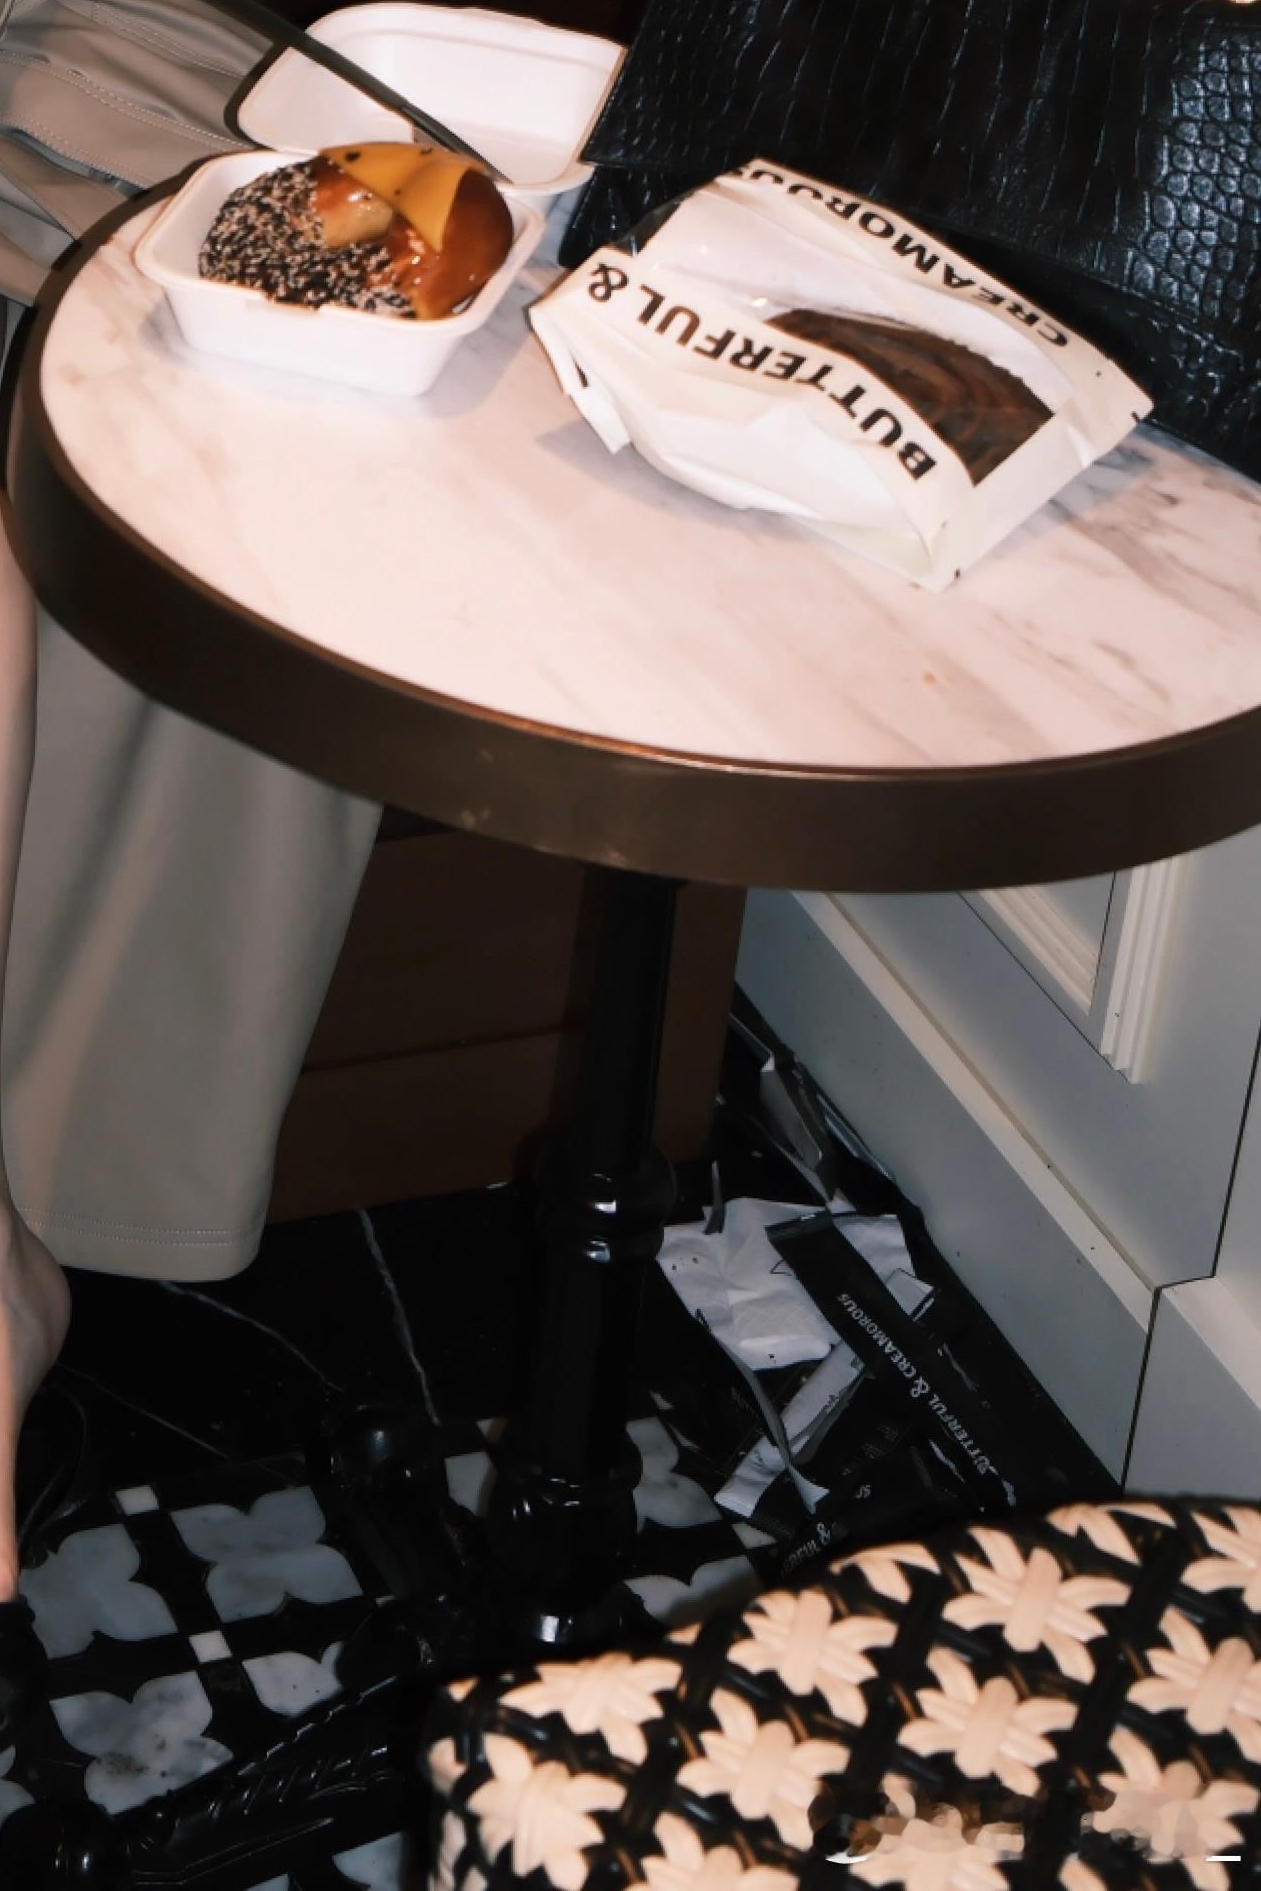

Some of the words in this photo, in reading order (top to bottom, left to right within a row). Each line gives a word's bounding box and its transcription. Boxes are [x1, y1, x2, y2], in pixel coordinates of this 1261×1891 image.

[585, 263, 629, 304] &
[736, 166, 1068, 348] CREAMOR
[637, 283, 938, 482] BUTTERFUL
[838, 1293, 917, 1378] CREAMOROUS
[910, 1375, 930, 1398] &
